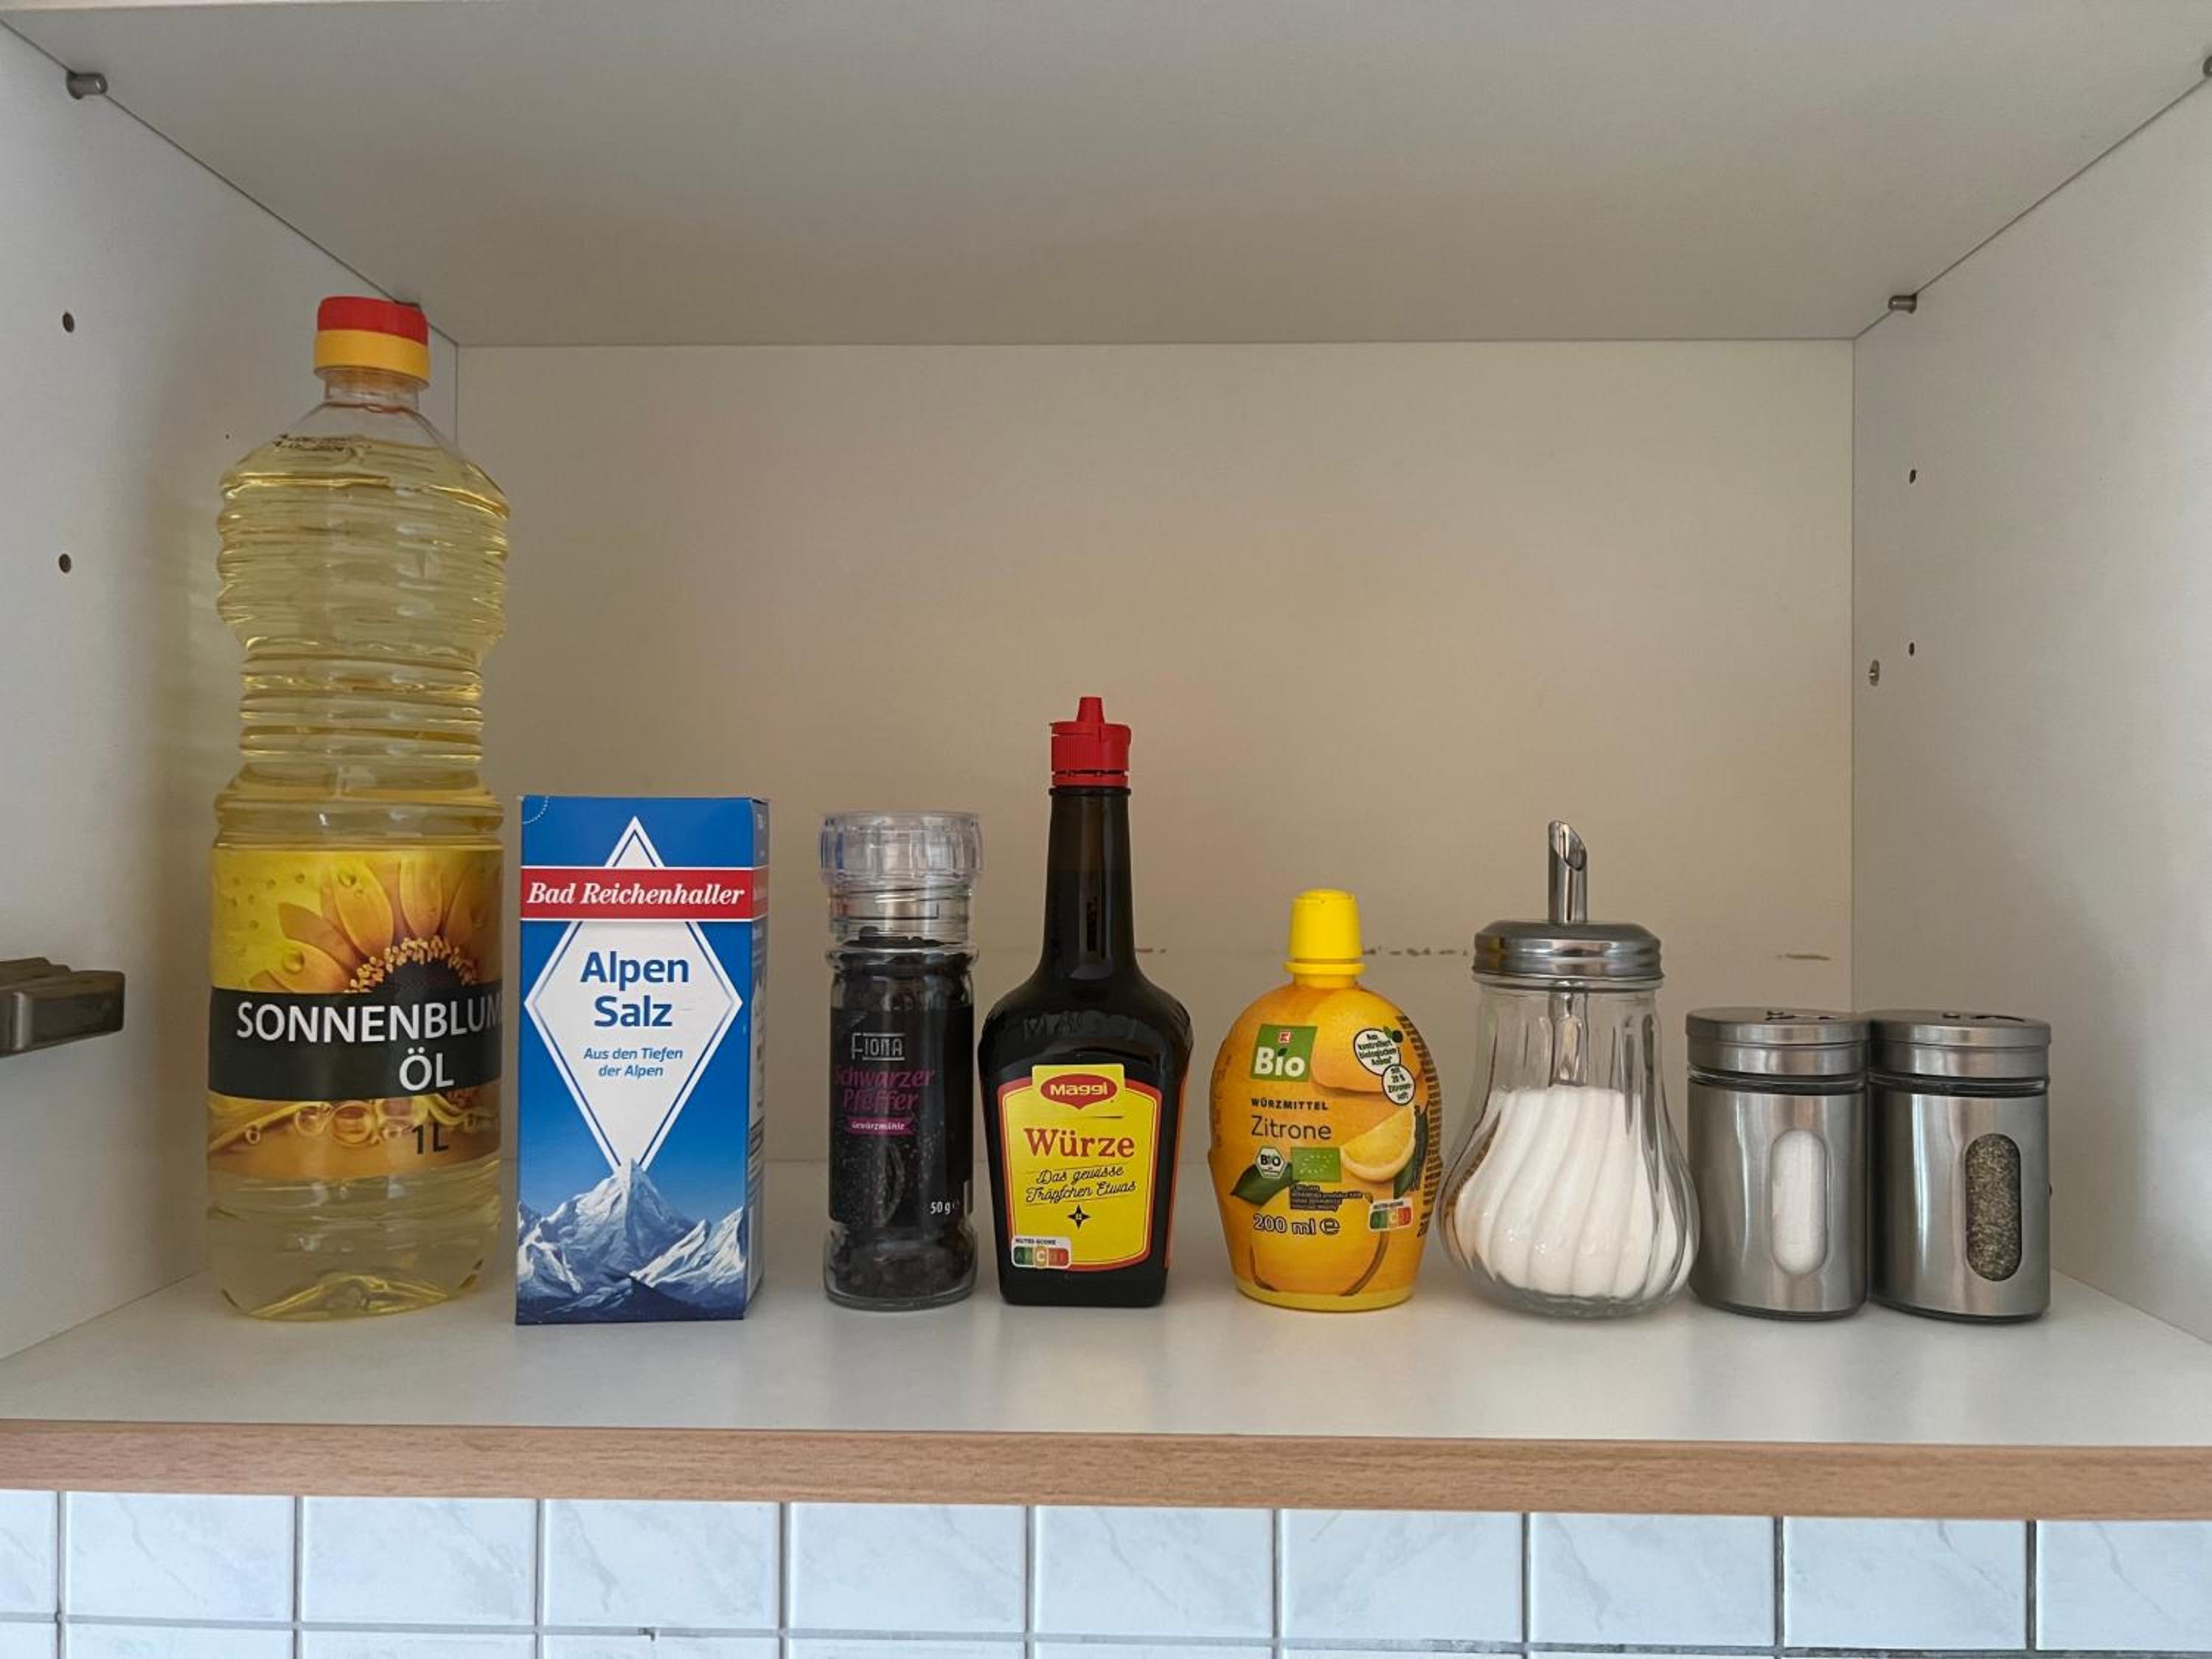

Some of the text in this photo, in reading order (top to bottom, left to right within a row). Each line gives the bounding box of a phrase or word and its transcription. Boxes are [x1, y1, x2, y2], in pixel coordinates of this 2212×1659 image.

[526, 883, 577, 905] Bad
[580, 883, 745, 905] Reichenhaller
[580, 951, 689, 991] Alpen
[594, 995, 673, 1028] Salz
[583, 1047, 684, 1064] Aus den Tiefen
[1254, 1047, 1306, 1077] Bio
[399, 1046, 455, 1091] ÖL
[598, 1064, 664, 1080] der Alpen
[1049, 1081, 1109, 1096] Maggi
[1251, 1097, 1329, 1111] WÜRZMITTEL
[1251, 1115, 1332, 1140] Zitrone
[1023, 1127, 1135, 1159] Würze
[1037, 1166, 1124, 1185] Das gewisse
[1096, 1180, 1136, 1196] Etwas
[1253, 1214, 1287, 1233] 200
[1291, 1217, 1316, 1235] ml
